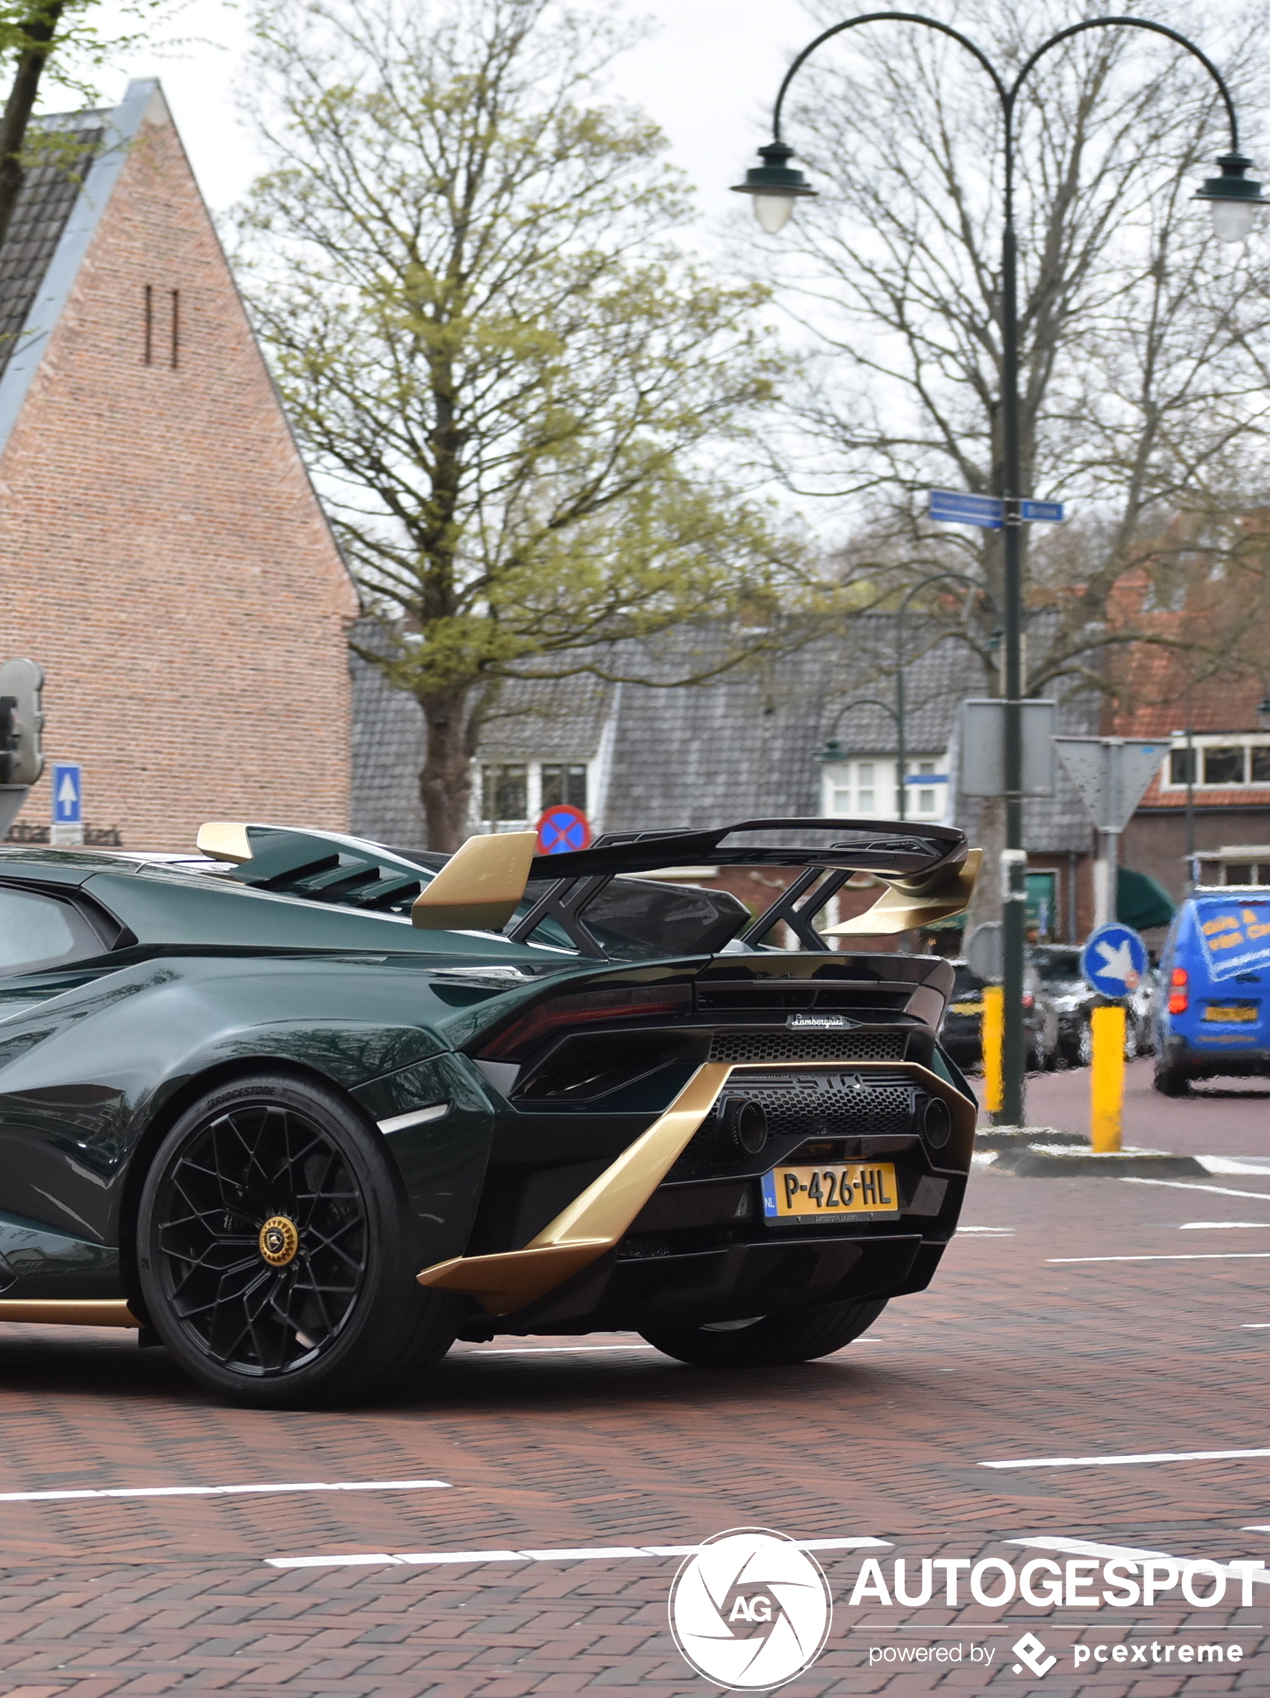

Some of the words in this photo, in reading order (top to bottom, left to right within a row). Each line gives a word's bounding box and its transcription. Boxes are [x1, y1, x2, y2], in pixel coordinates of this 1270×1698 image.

[791, 1013, 844, 1028] Lamborghini
[784, 1169, 892, 1209] P-426-HL
[764, 1197, 776, 1208] NL
